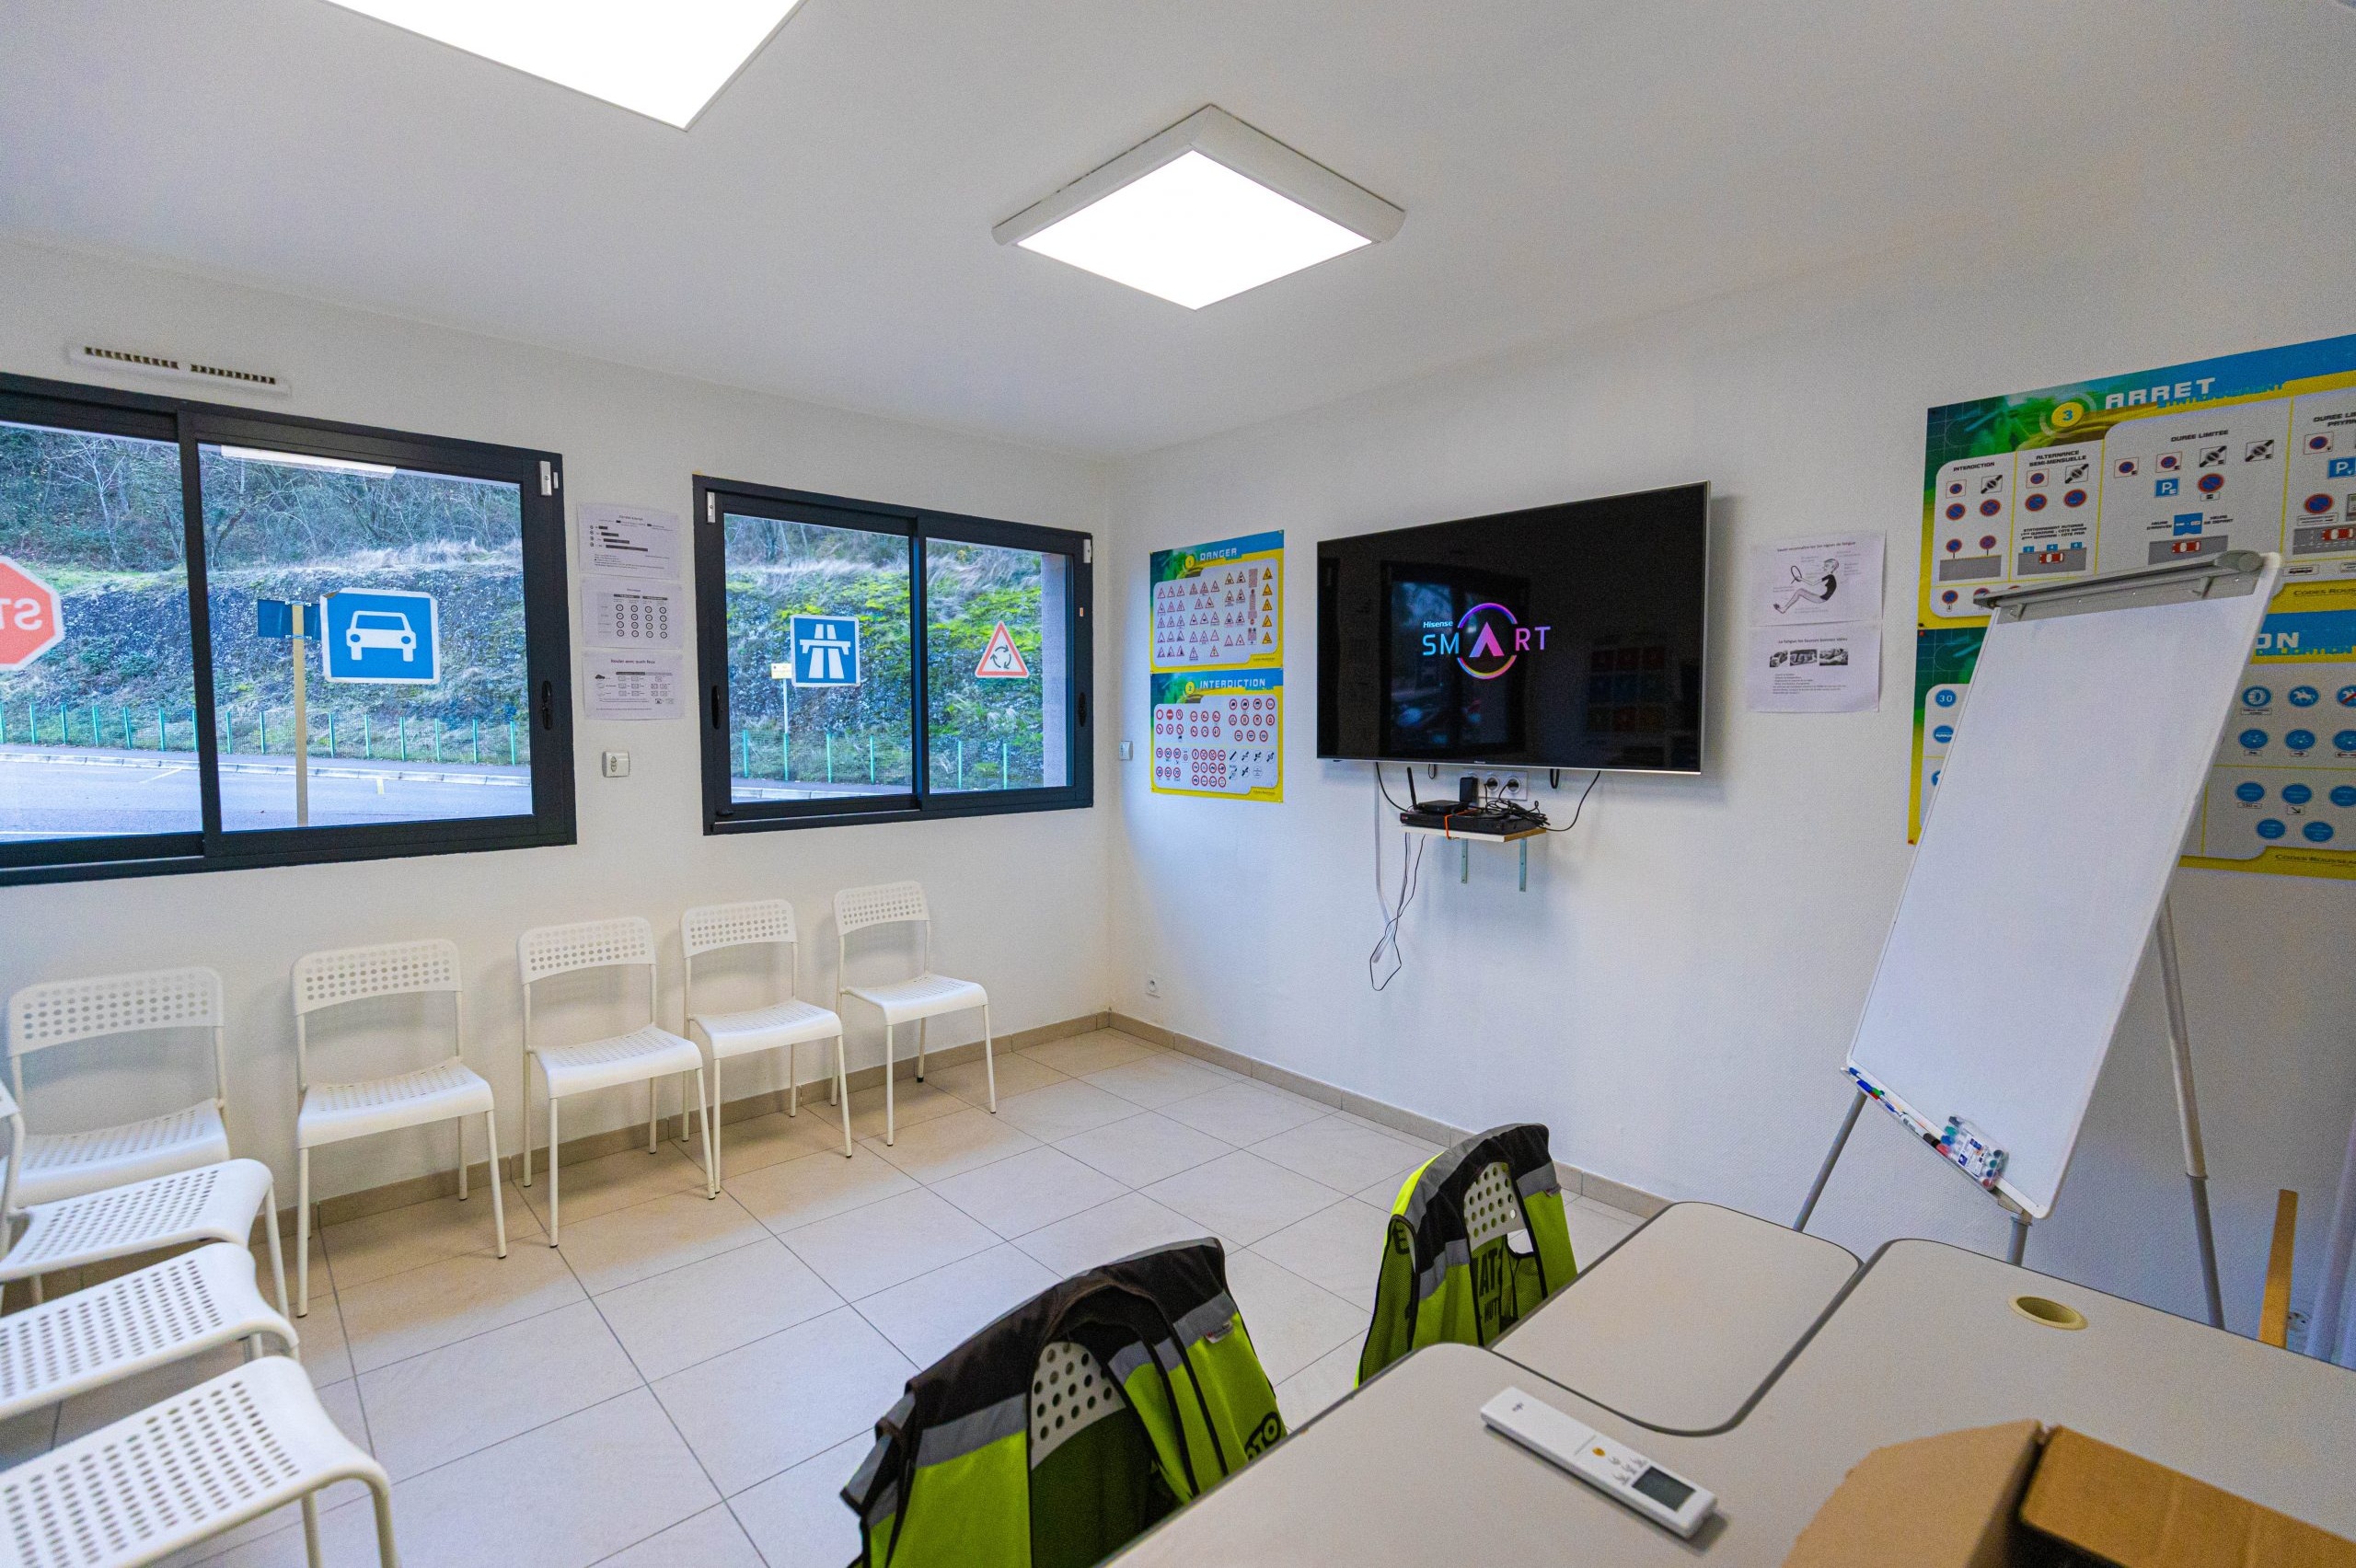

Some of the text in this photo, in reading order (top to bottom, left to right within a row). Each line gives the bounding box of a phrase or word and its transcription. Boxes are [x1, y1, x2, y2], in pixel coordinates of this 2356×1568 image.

[2105, 377, 2216, 410] ARRET
[2062, 409, 2073, 422] 3
[2199, 430, 2228, 439] LIMITEE
[2029, 455, 2087, 467] SEMI-MENSUELLE
[2036, 450, 2079, 460] ALTERNANCE
[1953, 461, 1995, 472] INTERDICTION
[1199, 548, 1238, 561] DANGER
[1423, 620, 1454, 628] Hisense
[1422, 621, 1552, 658] SMART
[1199, 677, 1266, 689] INTERDICTION
[1939, 695, 1953, 703] 30
